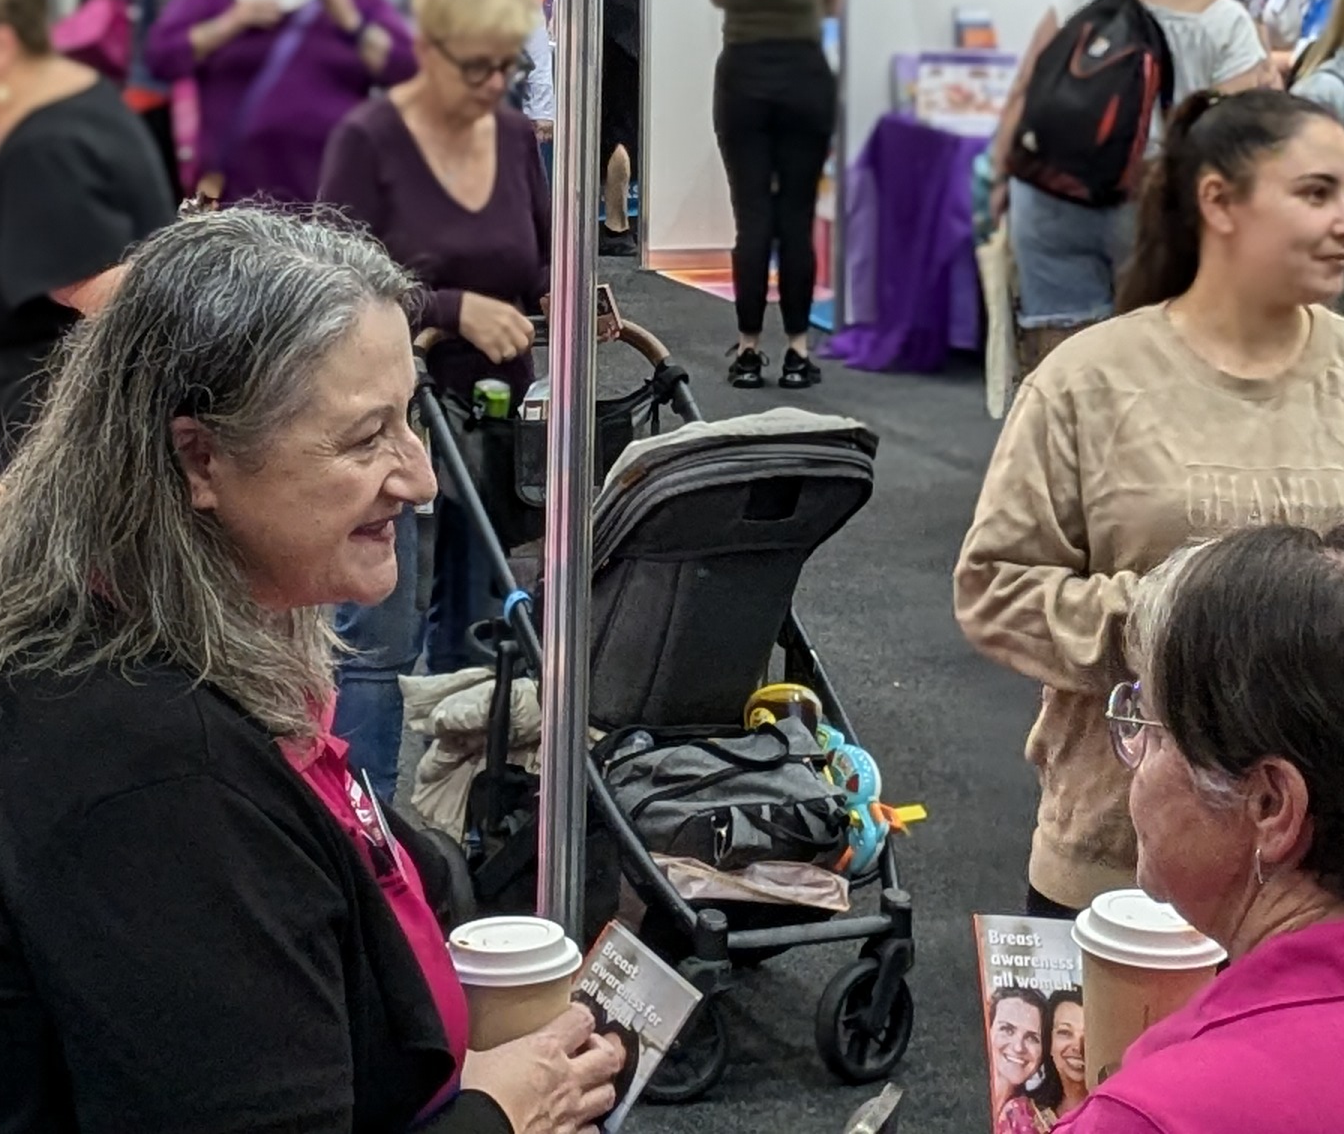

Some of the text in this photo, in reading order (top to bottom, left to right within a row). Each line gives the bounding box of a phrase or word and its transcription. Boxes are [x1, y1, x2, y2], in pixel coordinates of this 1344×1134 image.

[987, 929, 1042, 948] Breast
[601, 941, 640, 979] Breast
[990, 952, 1075, 970] awareness
[579, 978, 600, 998] all
[992, 971, 1014, 988] all
[590, 961, 663, 1027] awareness for
